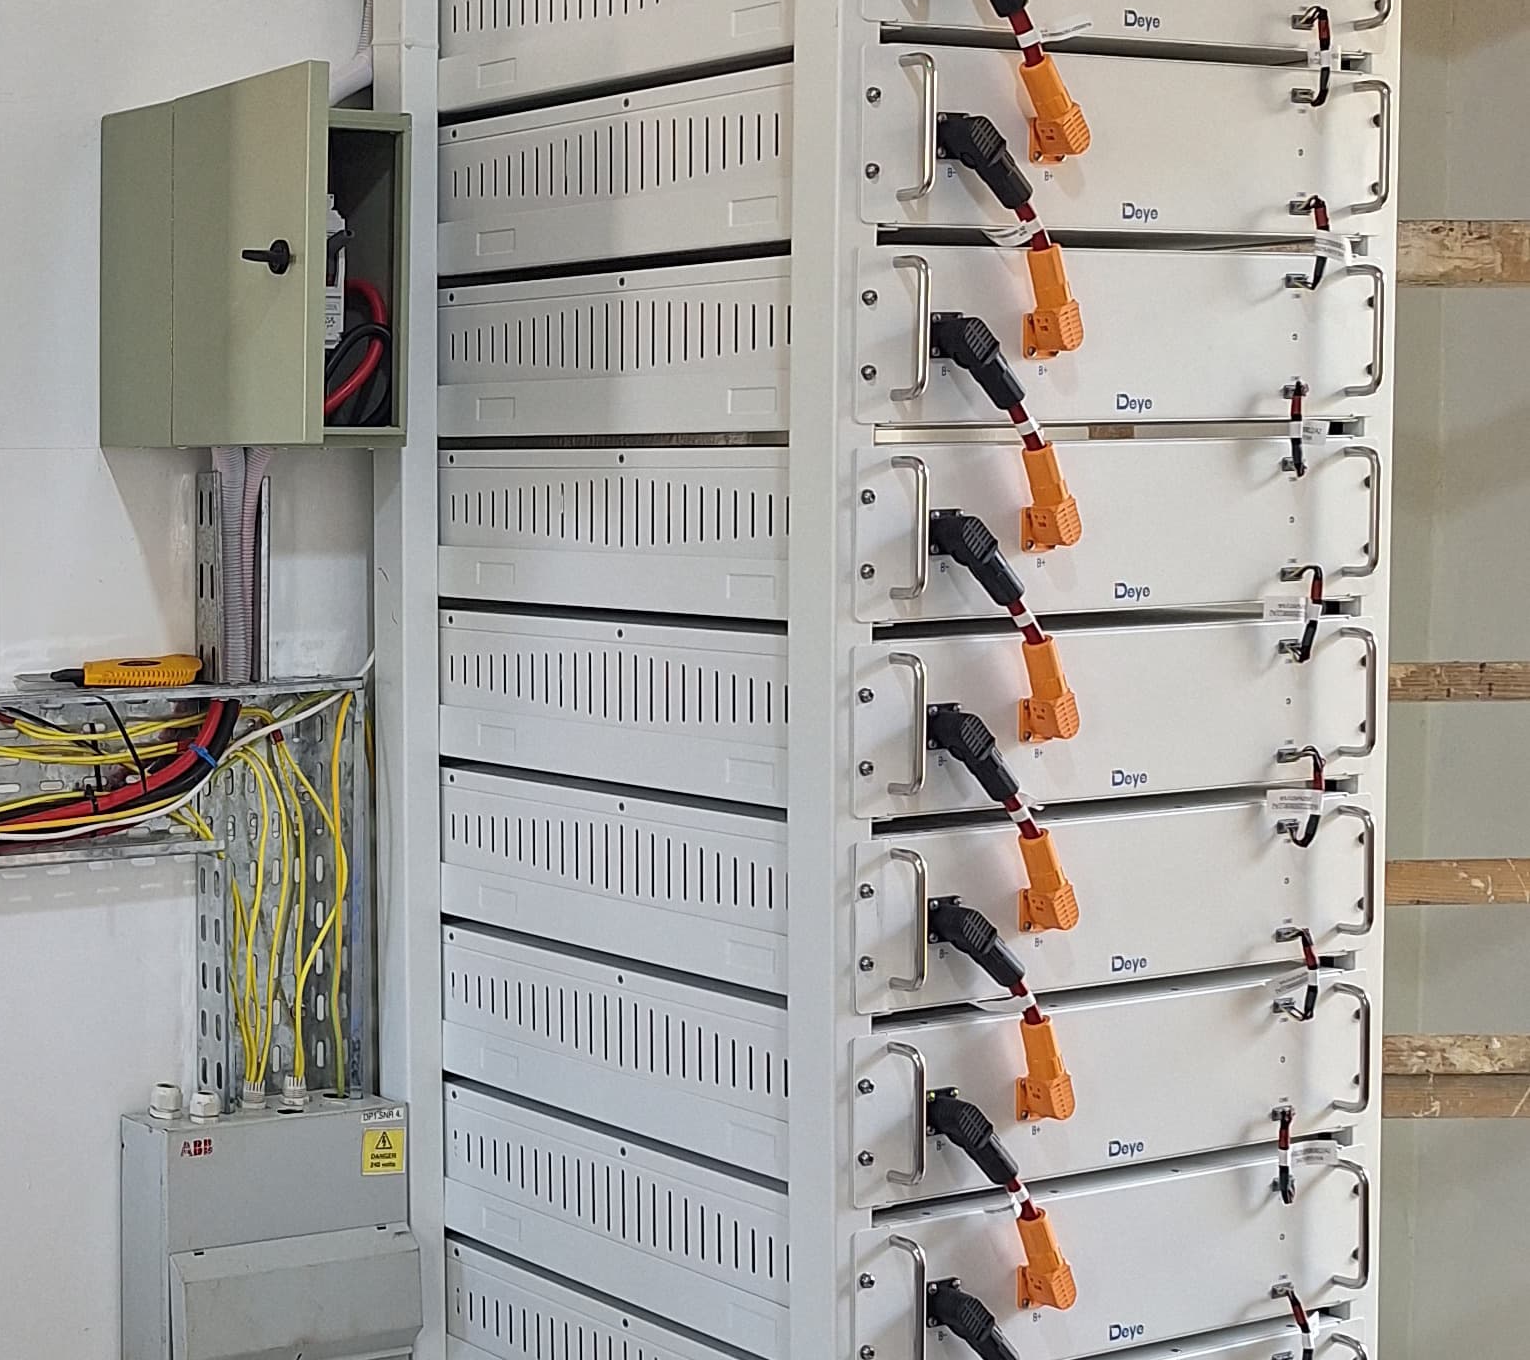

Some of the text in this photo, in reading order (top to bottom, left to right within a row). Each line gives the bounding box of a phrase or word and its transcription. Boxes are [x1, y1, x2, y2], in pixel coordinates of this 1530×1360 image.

[1124, 10, 1160, 30] Deye
[1122, 203, 1158, 222] Deye
[1116, 393, 1152, 413] Deye
[1114, 583, 1150, 602] Deye
[1111, 770, 1148, 788] Deye
[1111, 955, 1148, 974] Deye
[181, 1138, 213, 1157] ABB
[1108, 1140, 1144, 1158] Deye
[1109, 1323, 1144, 1341] Deye
